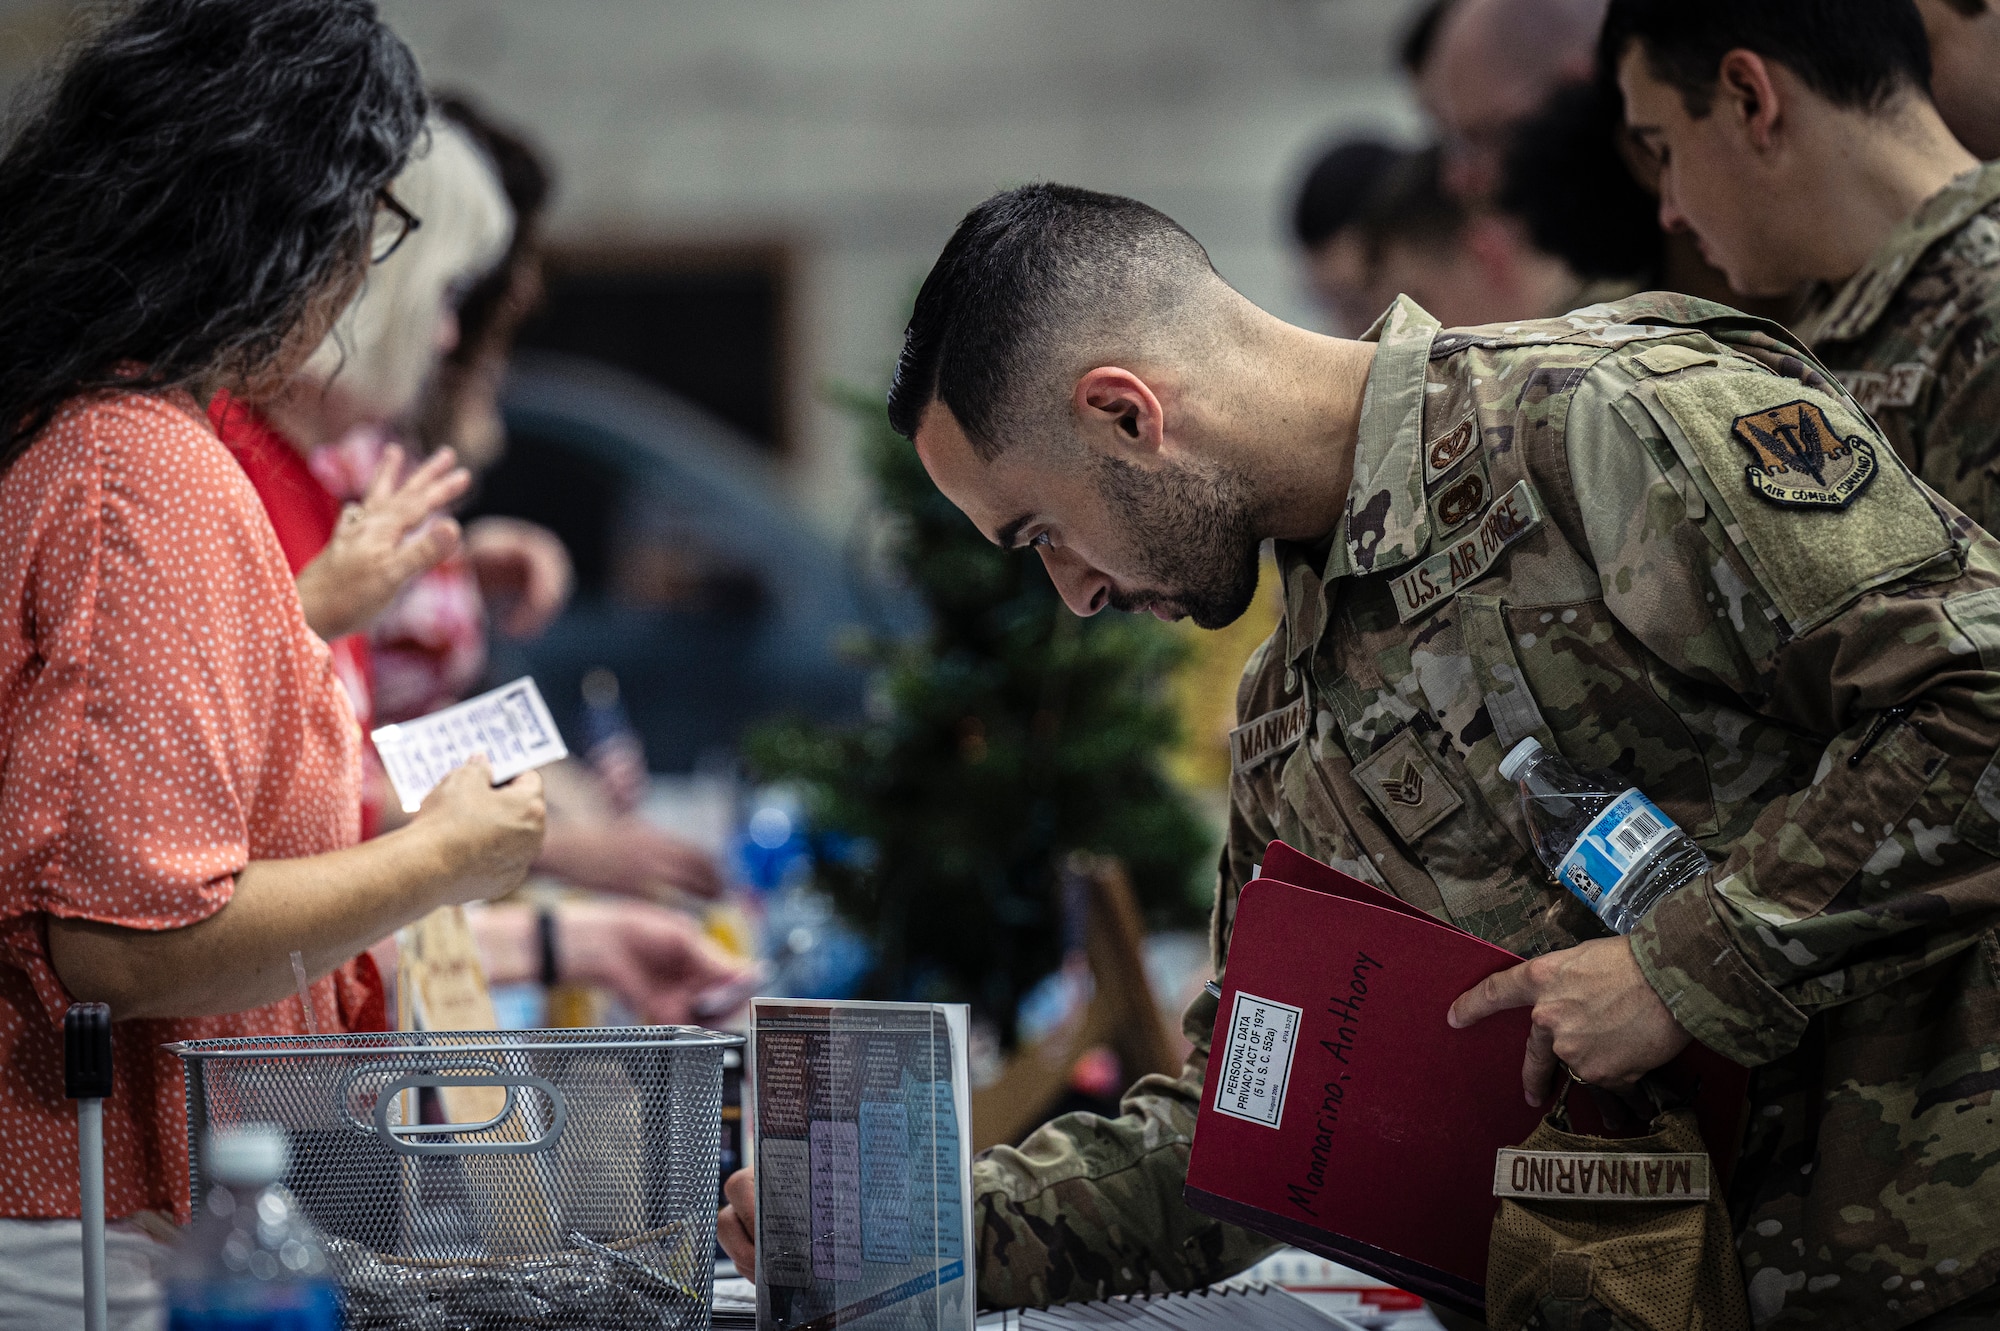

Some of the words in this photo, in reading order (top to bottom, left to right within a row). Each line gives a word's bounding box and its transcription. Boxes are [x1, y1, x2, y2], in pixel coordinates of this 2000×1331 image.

[1764, 484, 1786, 498] AIR
[1837, 456, 1870, 495] COMMAND
[1402, 568, 1442, 609] U.S.
[1449, 541, 1481, 587] AIR
[1480, 496, 1528, 562] FORCE
[1254, 1008, 1266, 1028] 1974
[1319, 951, 1384, 1065] Anthony
[1250, 1030, 1261, 1044] OF
[1262, 1027, 1278, 1052] 552a)
[1282, 1030, 1290, 1044] AFVA
[1226, 1043, 1246, 1095] PERSONAL
[1237, 1015, 1251, 1040] DATA
[1246, 1046, 1259, 1067] ACT
[1260, 1054, 1271, 1064] C.
[1258, 1066, 1269, 1075] S.
[1237, 1067, 1254, 1110] PRIVACY
[1255, 1077, 1266, 1087] U.
[1253, 1087, 1265, 1098] (5
[1268, 1095, 1277, 1112] August
[1511, 1155, 1692, 1196] MANNARINO
